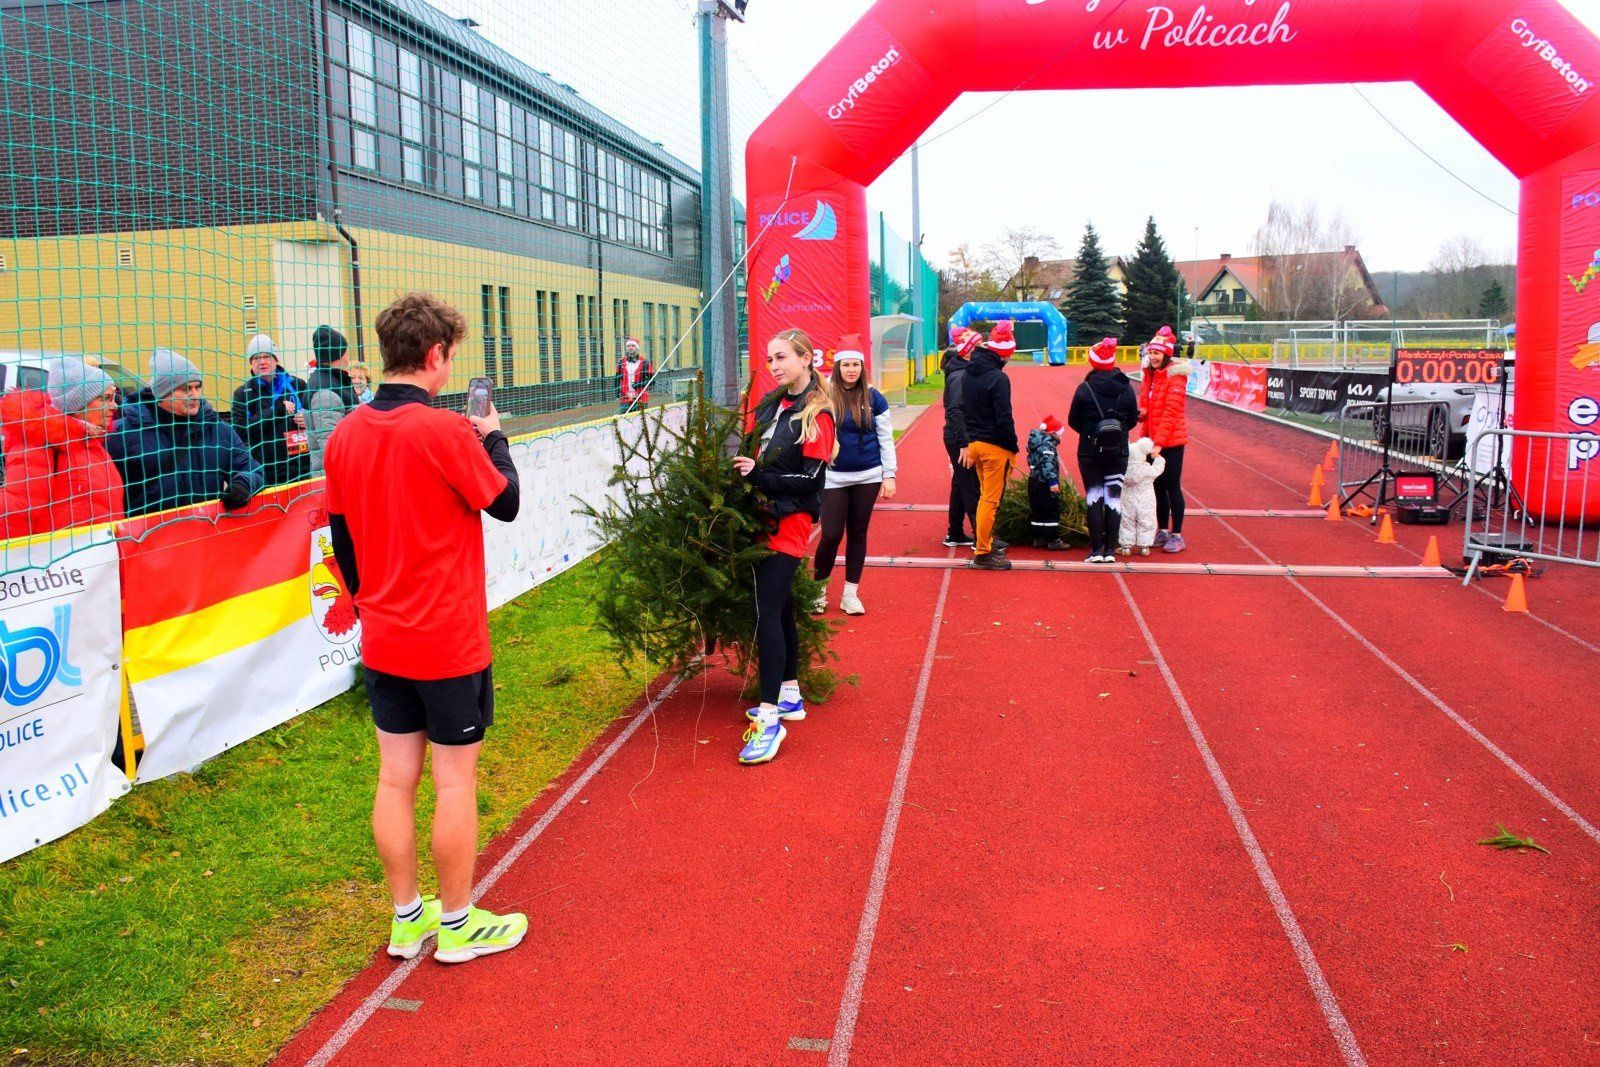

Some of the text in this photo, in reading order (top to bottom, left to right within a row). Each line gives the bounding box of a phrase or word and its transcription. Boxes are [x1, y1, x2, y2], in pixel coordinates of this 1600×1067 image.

[1092, 1, 1298, 51] w Policach
[1510, 18, 1588, 93] GryfBeton
[827, 49, 900, 119] GryfBeton
[758, 211, 810, 228] POLICE
[1396, 360, 1498, 384] 0:00:00
[1267, 377, 1284, 389] KIA
[1347, 383, 1373, 396] KIA
[1299, 386, 1338, 401] SPORT TO MY
